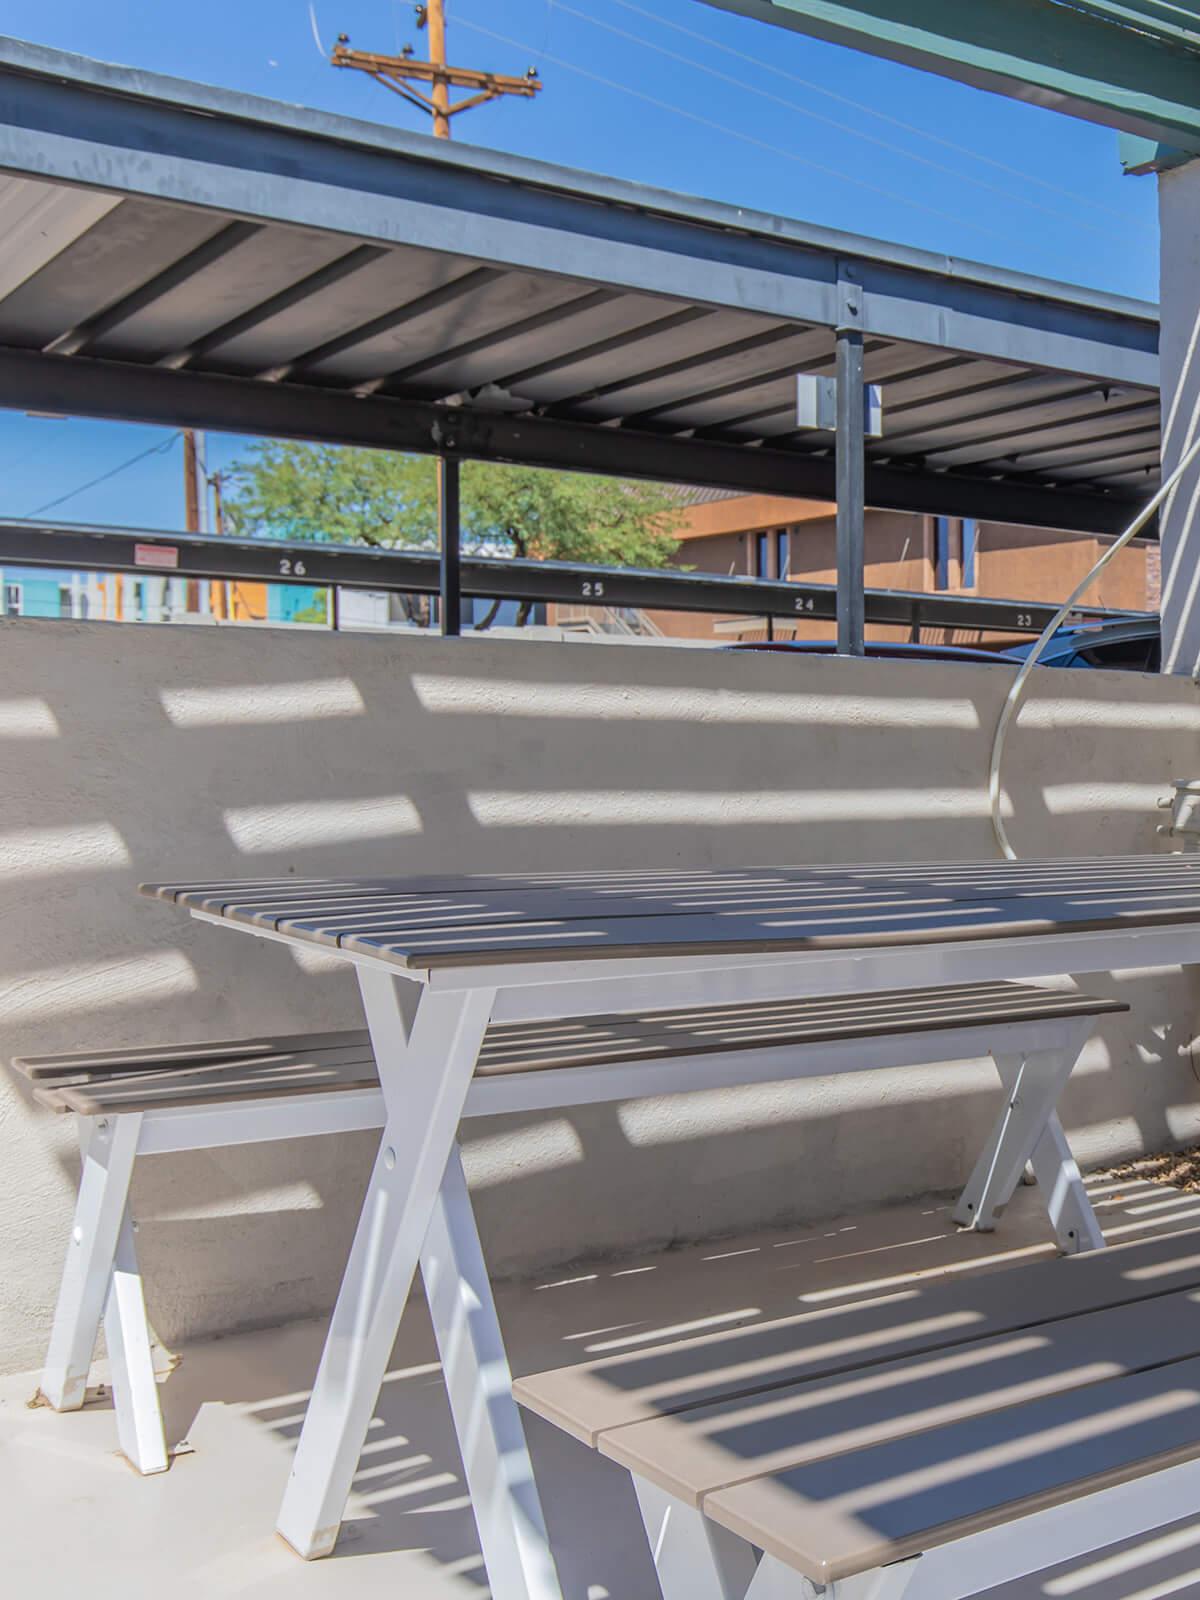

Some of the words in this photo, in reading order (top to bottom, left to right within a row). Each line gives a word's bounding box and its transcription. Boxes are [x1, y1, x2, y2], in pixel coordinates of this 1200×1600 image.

[279, 559, 306, 576] 26
[581, 581, 604, 597] 25
[794, 597, 814, 611] 24
[1016, 614, 1032, 627] 23
